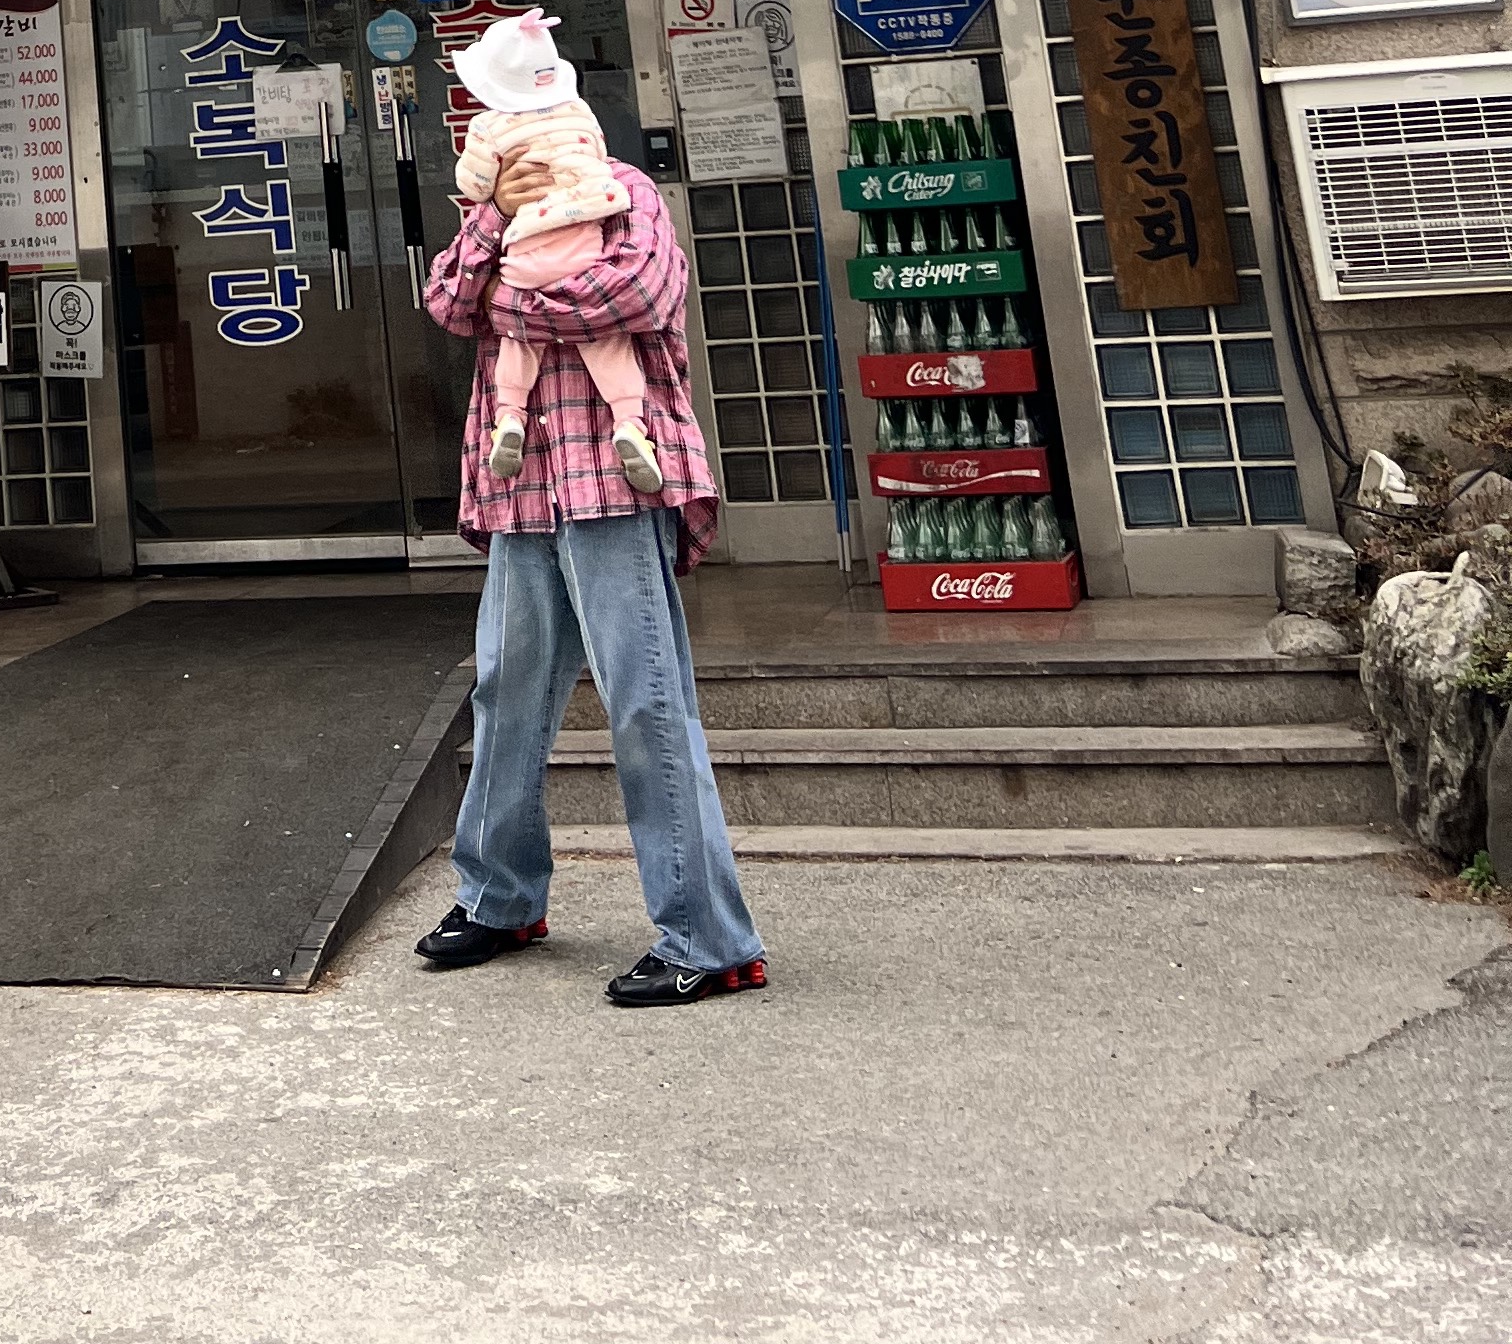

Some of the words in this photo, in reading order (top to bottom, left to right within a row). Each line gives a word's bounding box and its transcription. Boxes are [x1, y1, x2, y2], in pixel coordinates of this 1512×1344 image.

[17, 43, 56, 60] 52,000
[18, 68, 58, 85] 44,000
[21, 93, 60, 110] 17,000
[256, 85, 292, 104] 갈비탕
[28, 116, 61, 133] 9,000
[23, 140, 63, 157] 33,000
[32, 165, 65, 181] 9,000
[33, 188, 66, 204] 8,000
[35, 211, 68, 227] 8,000
[10, 236, 57, 249] 모시겠습니다
[898, 260, 971, 288] 칠성사이다
[931, 572, 1016, 603] Coca-Cola
